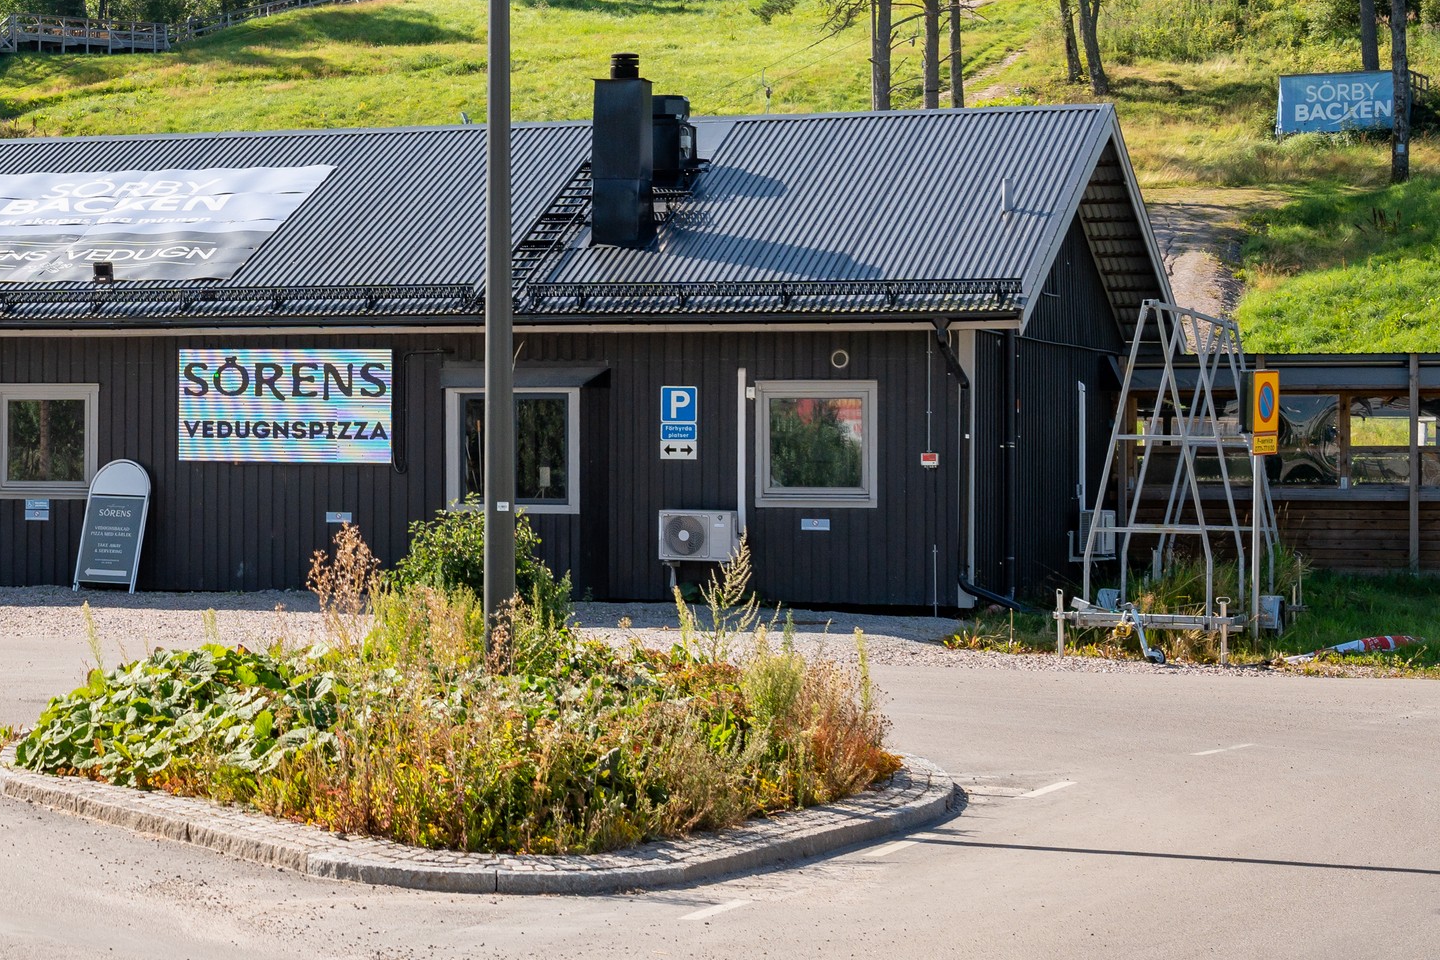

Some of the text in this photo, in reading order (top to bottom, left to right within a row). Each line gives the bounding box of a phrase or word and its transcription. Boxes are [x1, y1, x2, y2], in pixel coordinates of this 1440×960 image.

[1305, 81, 1379, 103] SÖRBY
[1295, 99, 1392, 123] BACKEN
[41, 178, 221, 199] SÖRBY
[67, 246, 217, 261] VEDUGN
[183, 356, 387, 401] SÖRENS
[671, 390, 690, 419] P
[183, 420, 389, 440] VEDUGNSPIZZA
[99, 508, 132, 518] SÖRENS
